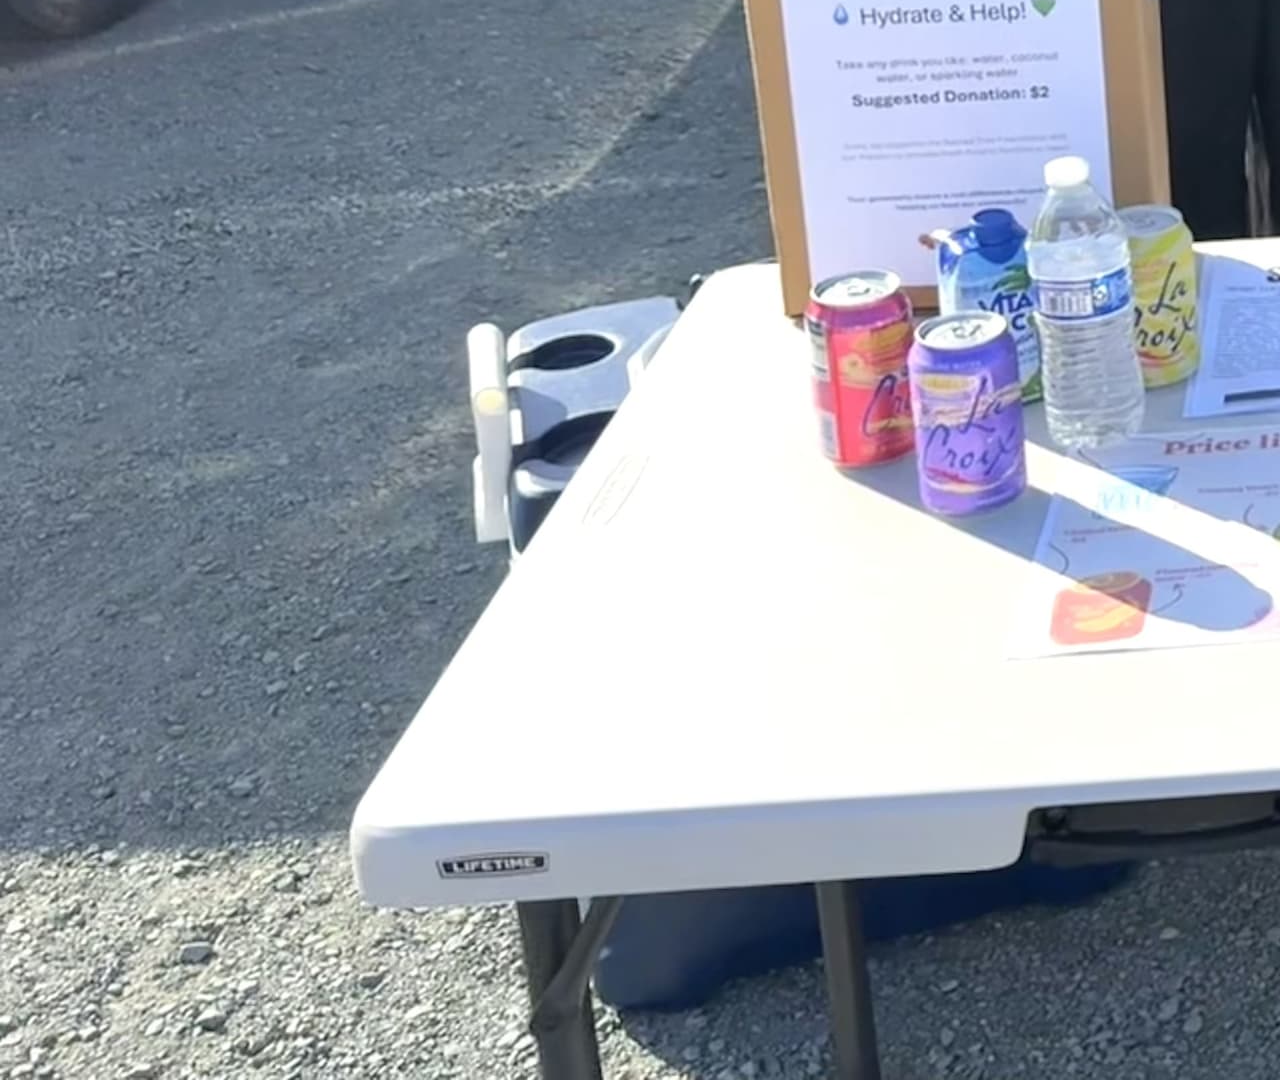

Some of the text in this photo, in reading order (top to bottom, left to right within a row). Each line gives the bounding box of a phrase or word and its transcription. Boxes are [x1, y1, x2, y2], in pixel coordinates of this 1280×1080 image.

[859, 1, 1027, 29] Hydrate & Help!
[866, 60, 887, 72] any
[852, 85, 1050, 108] Suggested Donation: $2
[978, 291, 1034, 314] VITA
[1134, 307, 1195, 353] roix
[960, 375, 1005, 434] La
[924, 422, 1017, 477] Croix
[1163, 435, 1252, 458] Price
[453, 856, 536, 873] LIFETIME
